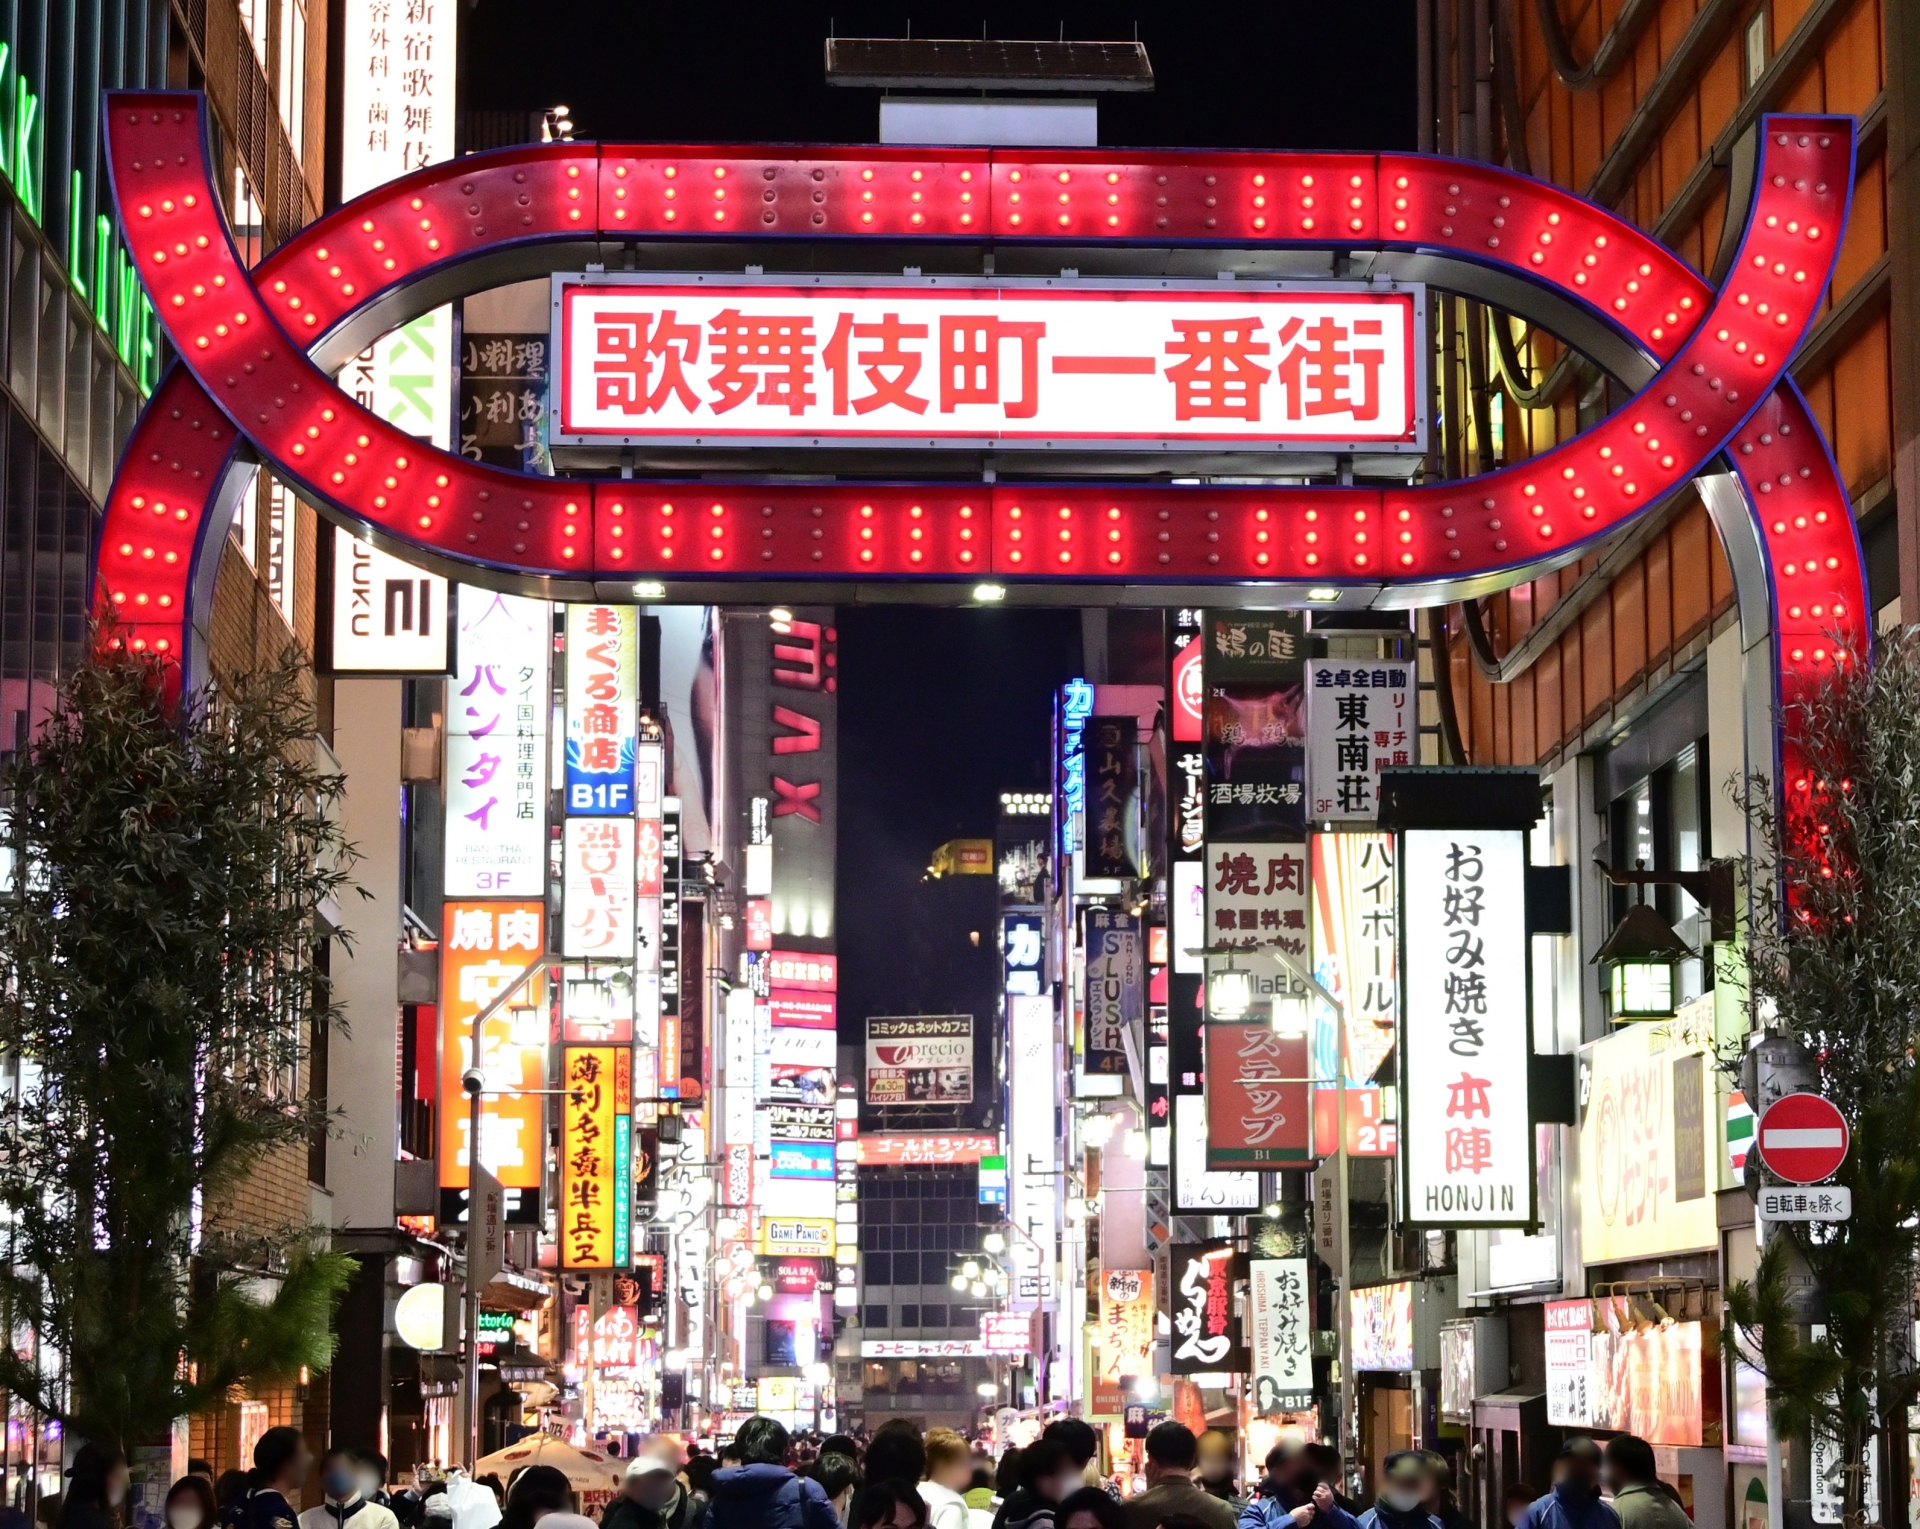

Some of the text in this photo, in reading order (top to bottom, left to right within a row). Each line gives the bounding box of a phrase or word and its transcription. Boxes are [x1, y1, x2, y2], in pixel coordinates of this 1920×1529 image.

[594, 308, 1384, 422] 歌舞伎町一番街
[1174, 635, 1190, 648] 4F
[582, 607, 620, 772] まぐろ商店
[1315, 669, 1406, 689] 全卓全自動
[459, 663, 508, 831] バンタイ
[516, 665, 535, 820] タイ国料理専門店
[1335, 693, 1370, 814] 東南荘
[571, 783, 629, 809] B1F
[1210, 783, 1302, 805] 酒場牧場
[1316, 800, 1333, 813] 3F
[476, 871, 512, 889] 3F
[1215, 852, 1305, 896] 焼肉
[449, 908, 540, 951] 焼肉
[1095, 913, 1130, 929] 麻雀
[1215, 908, 1306, 930] 韓国料理
[1361, 842, 1394, 1013] ハイボール
[1443, 841, 1487, 1058] お好み焼き
[870, 1021, 970, 1035] コミック&ネットカフェ
[1101, 1055, 1126, 1071] 4F
[1237, 1028, 1286, 1146] ステップ
[1446, 1071, 1494, 1175] 本陣
[877, 1137, 993, 1152] ゴールドラッシュ
[1358, 1126, 1396, 1152] 2F
[1254, 1150, 1271, 1161] B1
[1426, 1184, 1514, 1212] HONJIN
[1765, 1194, 1843, 1214] 自転車を除く
[1321, 1177, 1334, 1247] 劇場通り一番街
[770, 1223, 820, 1241] GAME PANIC
[778, 1266, 814, 1276] SOLA SPA
[1109, 1276, 1139, 1294] 新宿
[1256, 1270, 1267, 1313] HIROSHIMA
[1272, 1269, 1308, 1377] お好み焼き
[1096, 1395, 1119, 1403] ONLINE
[1285, 1395, 1312, 1408] B1F
[1815, 1442, 1826, 1495] Operation
